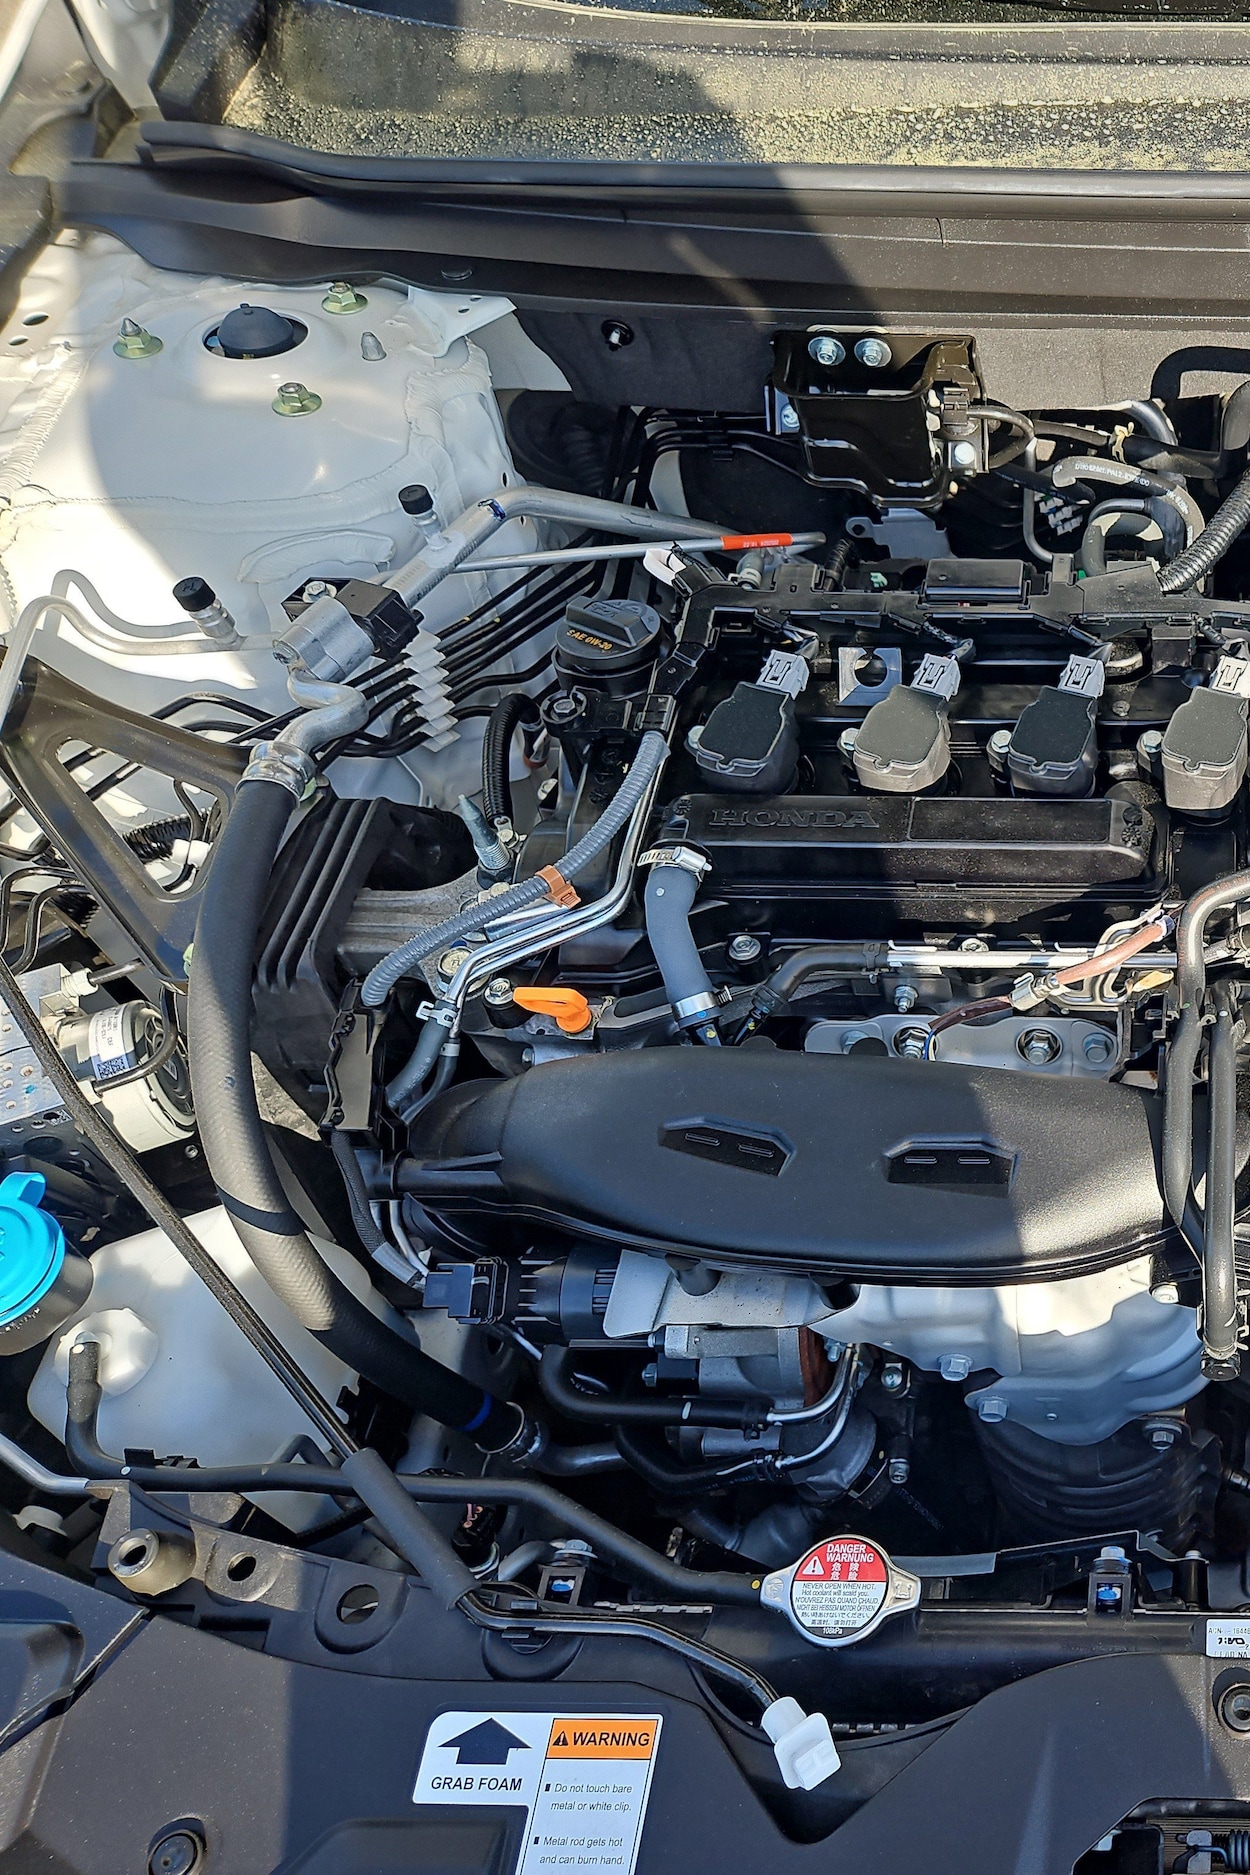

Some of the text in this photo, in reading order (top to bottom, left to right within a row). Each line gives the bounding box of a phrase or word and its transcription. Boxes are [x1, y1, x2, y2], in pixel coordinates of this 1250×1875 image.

[566, 629, 613, 651] SAE 0W-20
[708, 808, 880, 828] HONDA
[827, 1544, 866, 1553] DANGER
[826, 1553, 874, 1562] WARNUNG
[573, 1732, 650, 1747] WARNING
[431, 1776, 522, 1791] GRAB FOAM
[554, 1784, 632, 1793] Do not touch bare
[551, 1802, 575, 1810] metal
[589, 1802, 612, 1811] white
[614, 1802, 631, 1812] clip.
[543, 1837, 622, 1848] Metal rod gets hot
[540, 1855, 625, 1865] and can burn hand.
